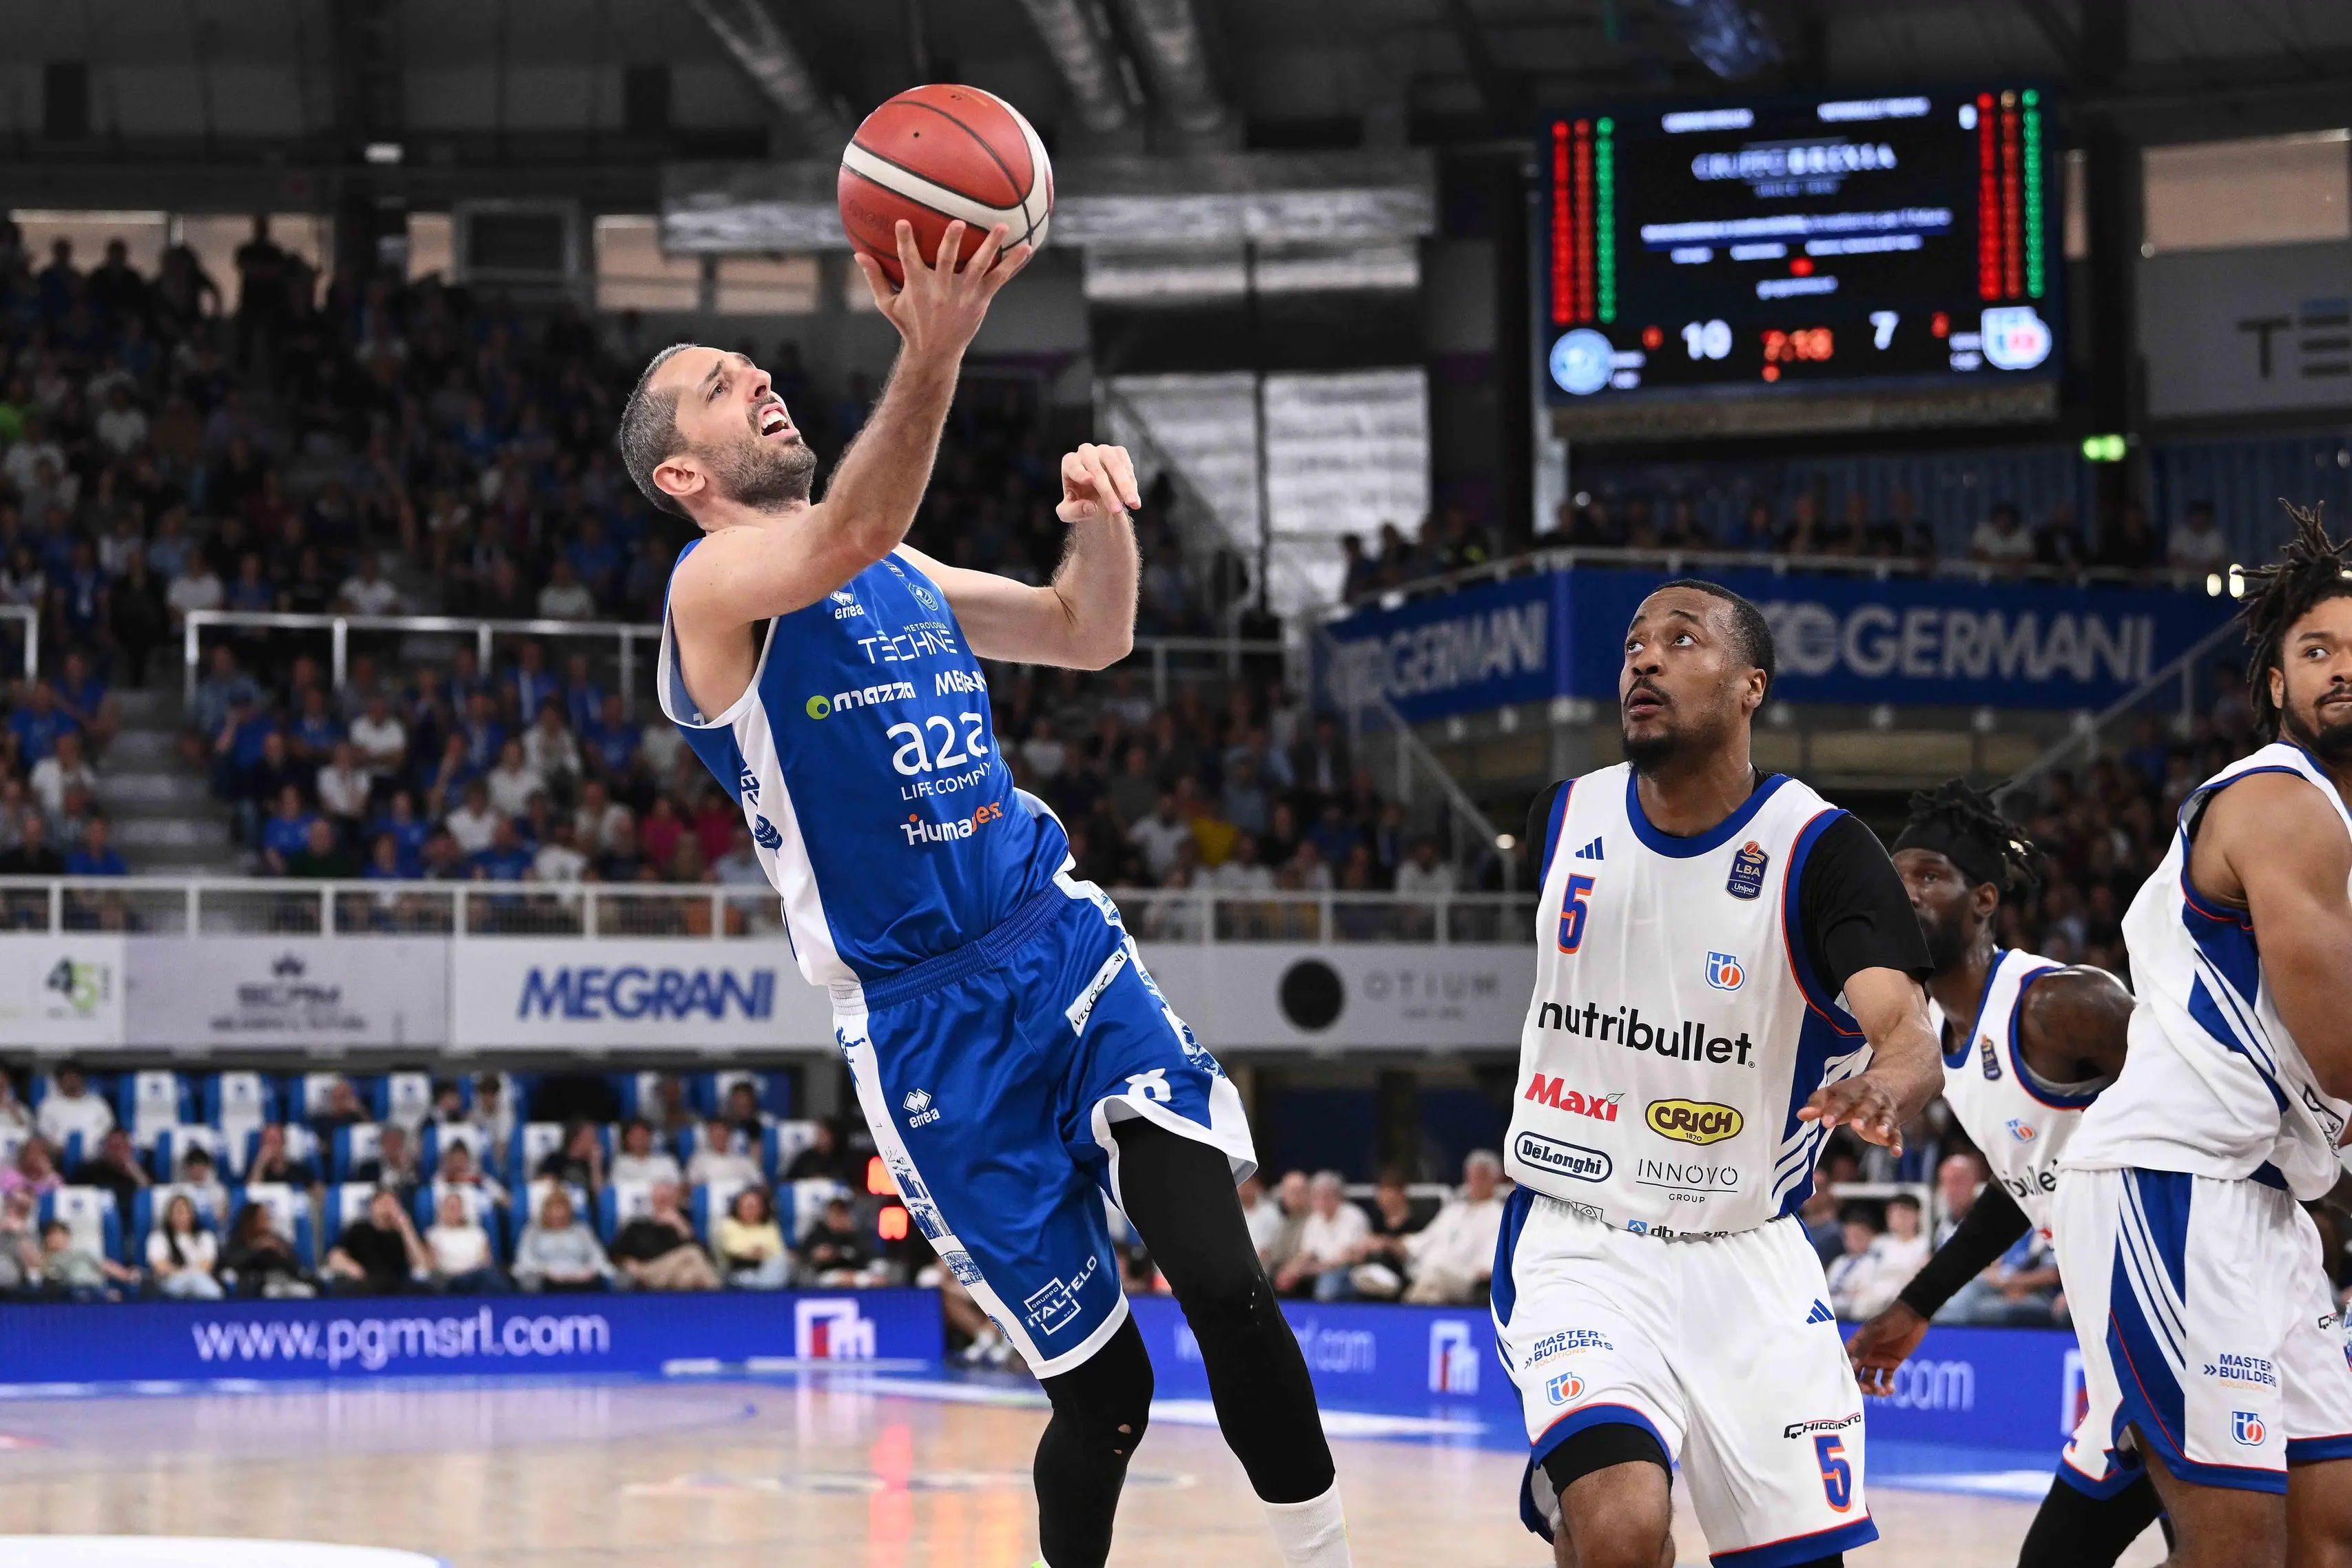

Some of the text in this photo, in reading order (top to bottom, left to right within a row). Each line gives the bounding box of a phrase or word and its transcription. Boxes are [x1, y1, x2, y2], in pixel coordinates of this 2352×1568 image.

[1681, 319, 1732, 360] 10
[1869, 311, 1900, 350] 7
[903, 622, 947, 632] METROLOGIA
[1841, 604, 2156, 683] GERMANI
[901, 761, 991, 801] LIFE COMPNY
[1736, 863, 1760, 877] LBA
[1734, 883, 1755, 894] Unipol
[1557, 874, 1596, 954] 5
[518, 965, 776, 1021] MEGRANI
[1538, 1002, 1753, 1066] nutribullet
[1524, 1073, 1619, 1122] Maxi
[1655, 1106, 1733, 1134] CRICH
[1685, 1132, 1702, 1142] 1870
[1638, 1158, 1738, 1186] INNOVO
[1669, 1193, 1705, 1204] GROUP
[1026, 1255, 1097, 1328] ITALTELO
[1031, 1286, 1059, 1308] GRUPPO
[192, 1306, 609, 1369] www.pgmsrl.com
[1534, 1330, 1599, 1352] MASTER
[1534, 1339, 1614, 1362] BUILDERS
[1535, 1348, 1587, 1369] SOLUTIONS
[2220, 1354, 2271, 1371] MASTER
[2219, 1366, 2277, 1388] BUILDERS
[1813, 1434, 1852, 1513] 5
